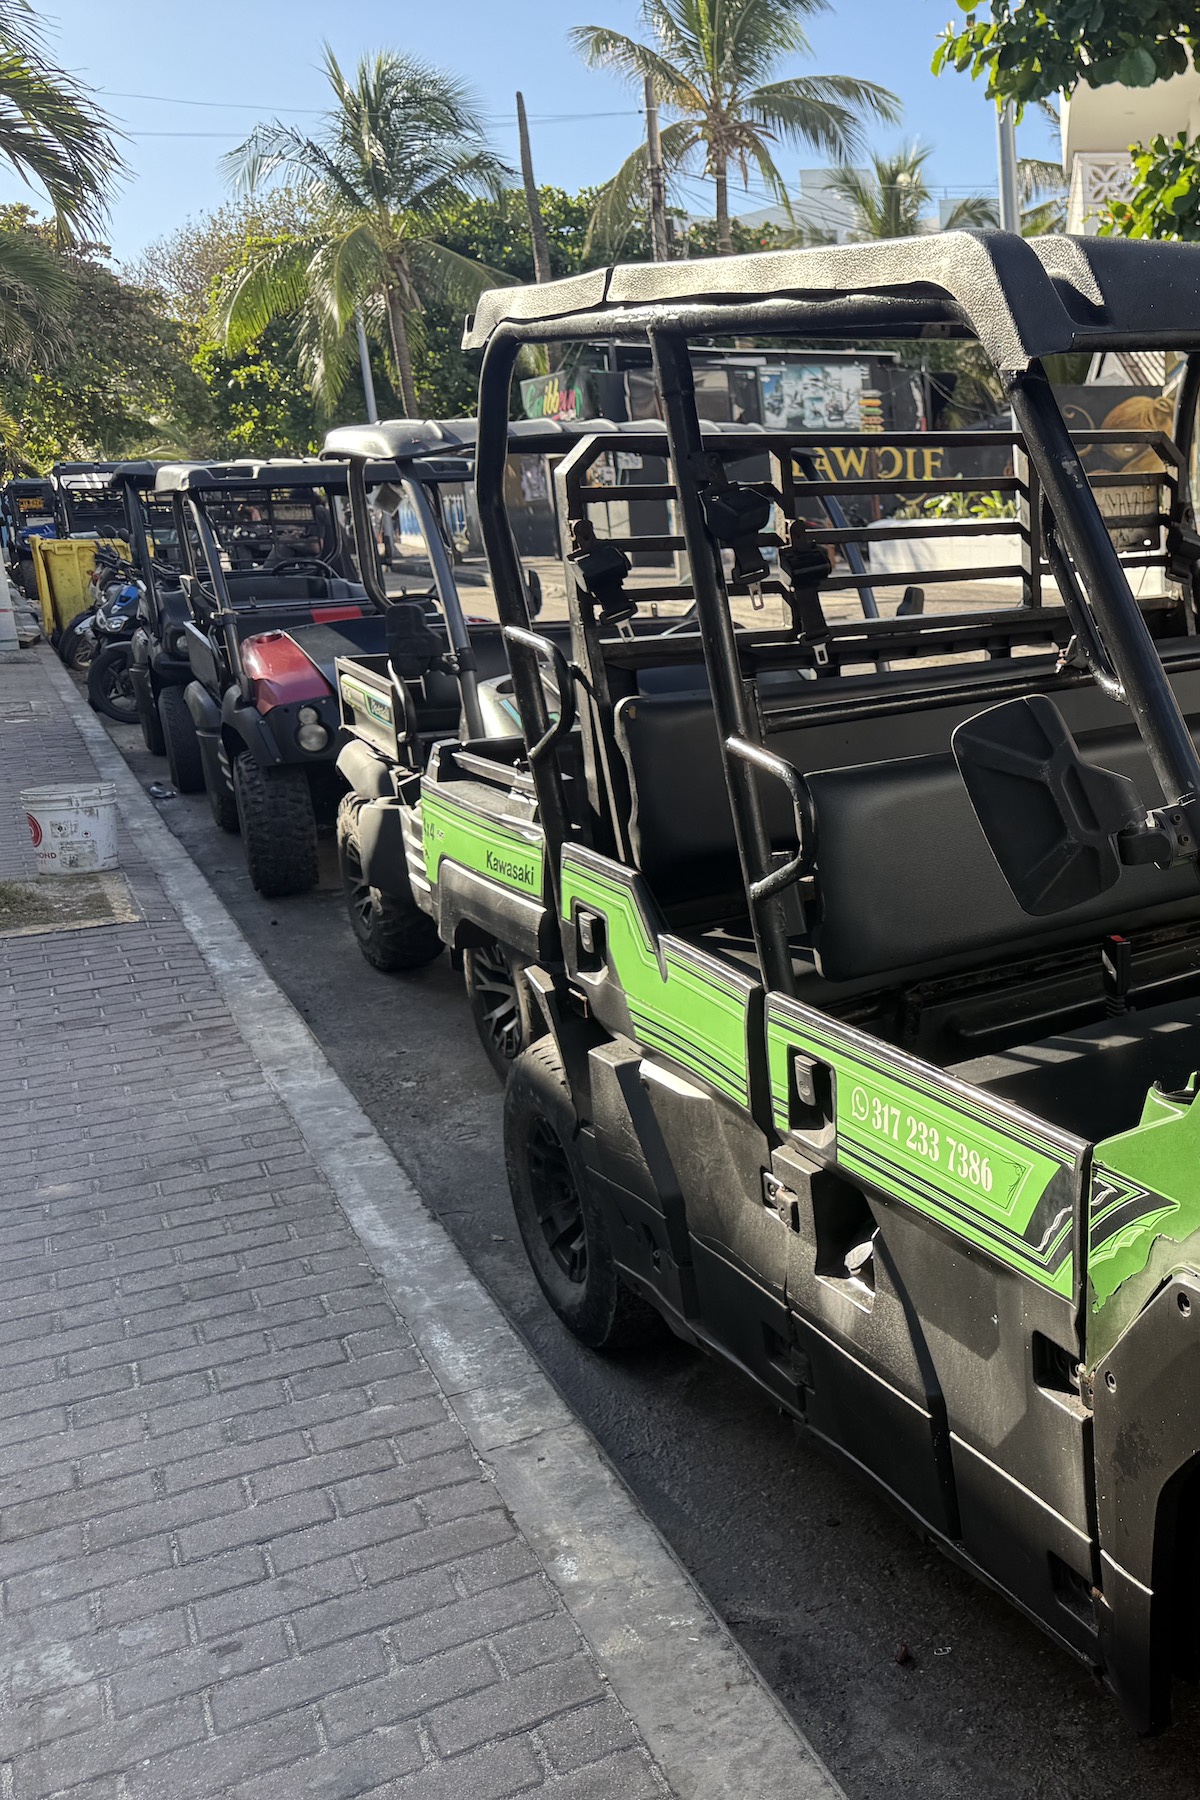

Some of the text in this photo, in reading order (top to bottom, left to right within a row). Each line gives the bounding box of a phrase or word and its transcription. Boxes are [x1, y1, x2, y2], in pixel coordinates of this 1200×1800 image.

[486, 850, 534, 886] Kawasaki
[872, 1097, 993, 1192] 317 233 7386
